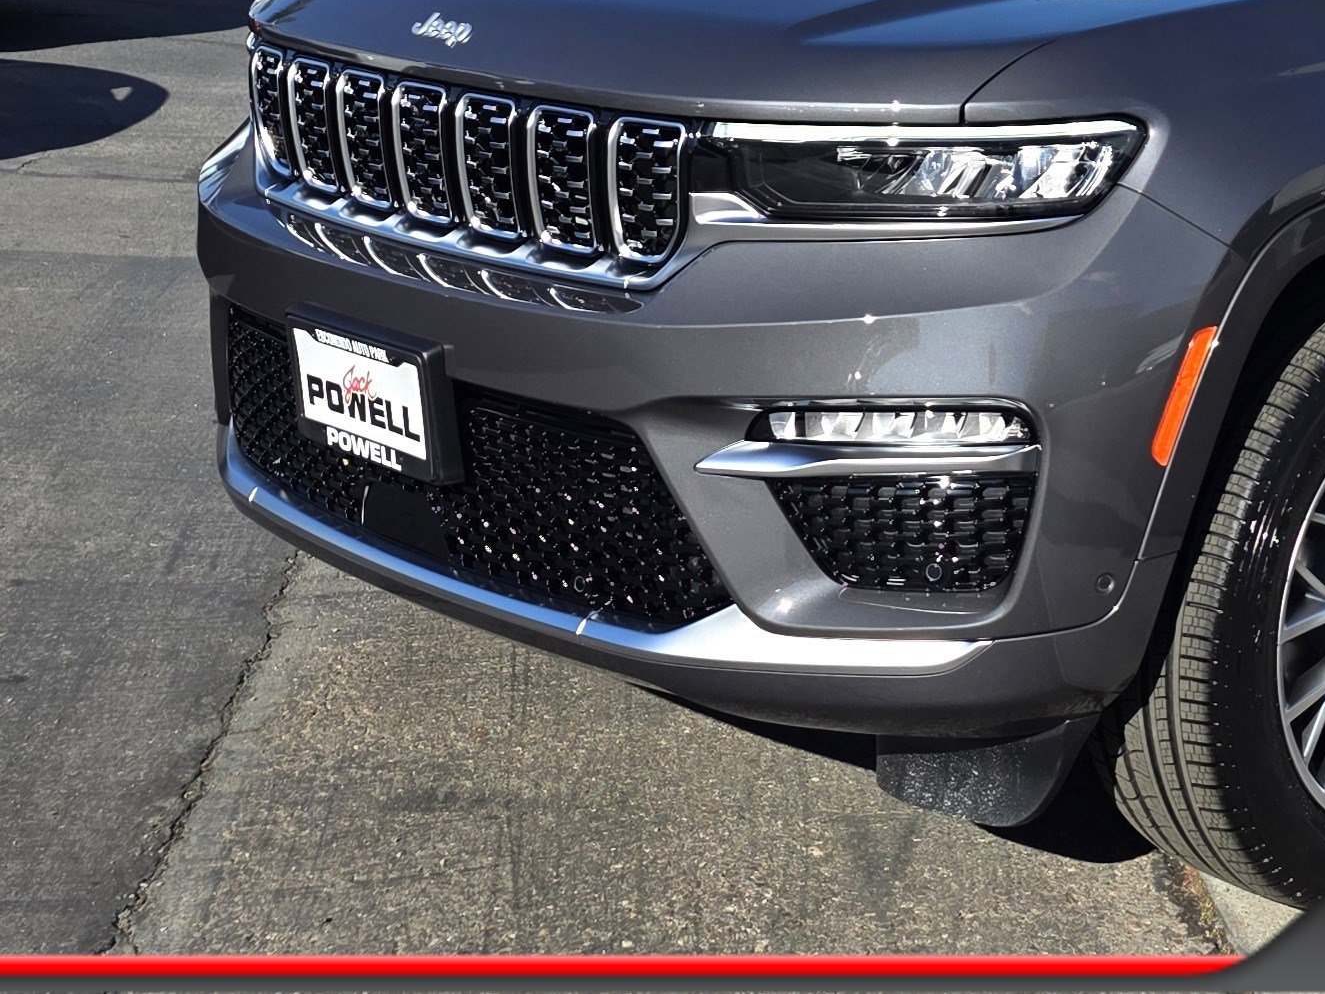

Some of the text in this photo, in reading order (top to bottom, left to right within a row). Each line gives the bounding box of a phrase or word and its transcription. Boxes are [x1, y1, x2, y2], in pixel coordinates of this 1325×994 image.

[411, 12, 473, 48] Jeep
[343, 365, 377, 404] Jack
[306, 373, 420, 443] POWELL
[326, 426, 402, 472] POWELL
